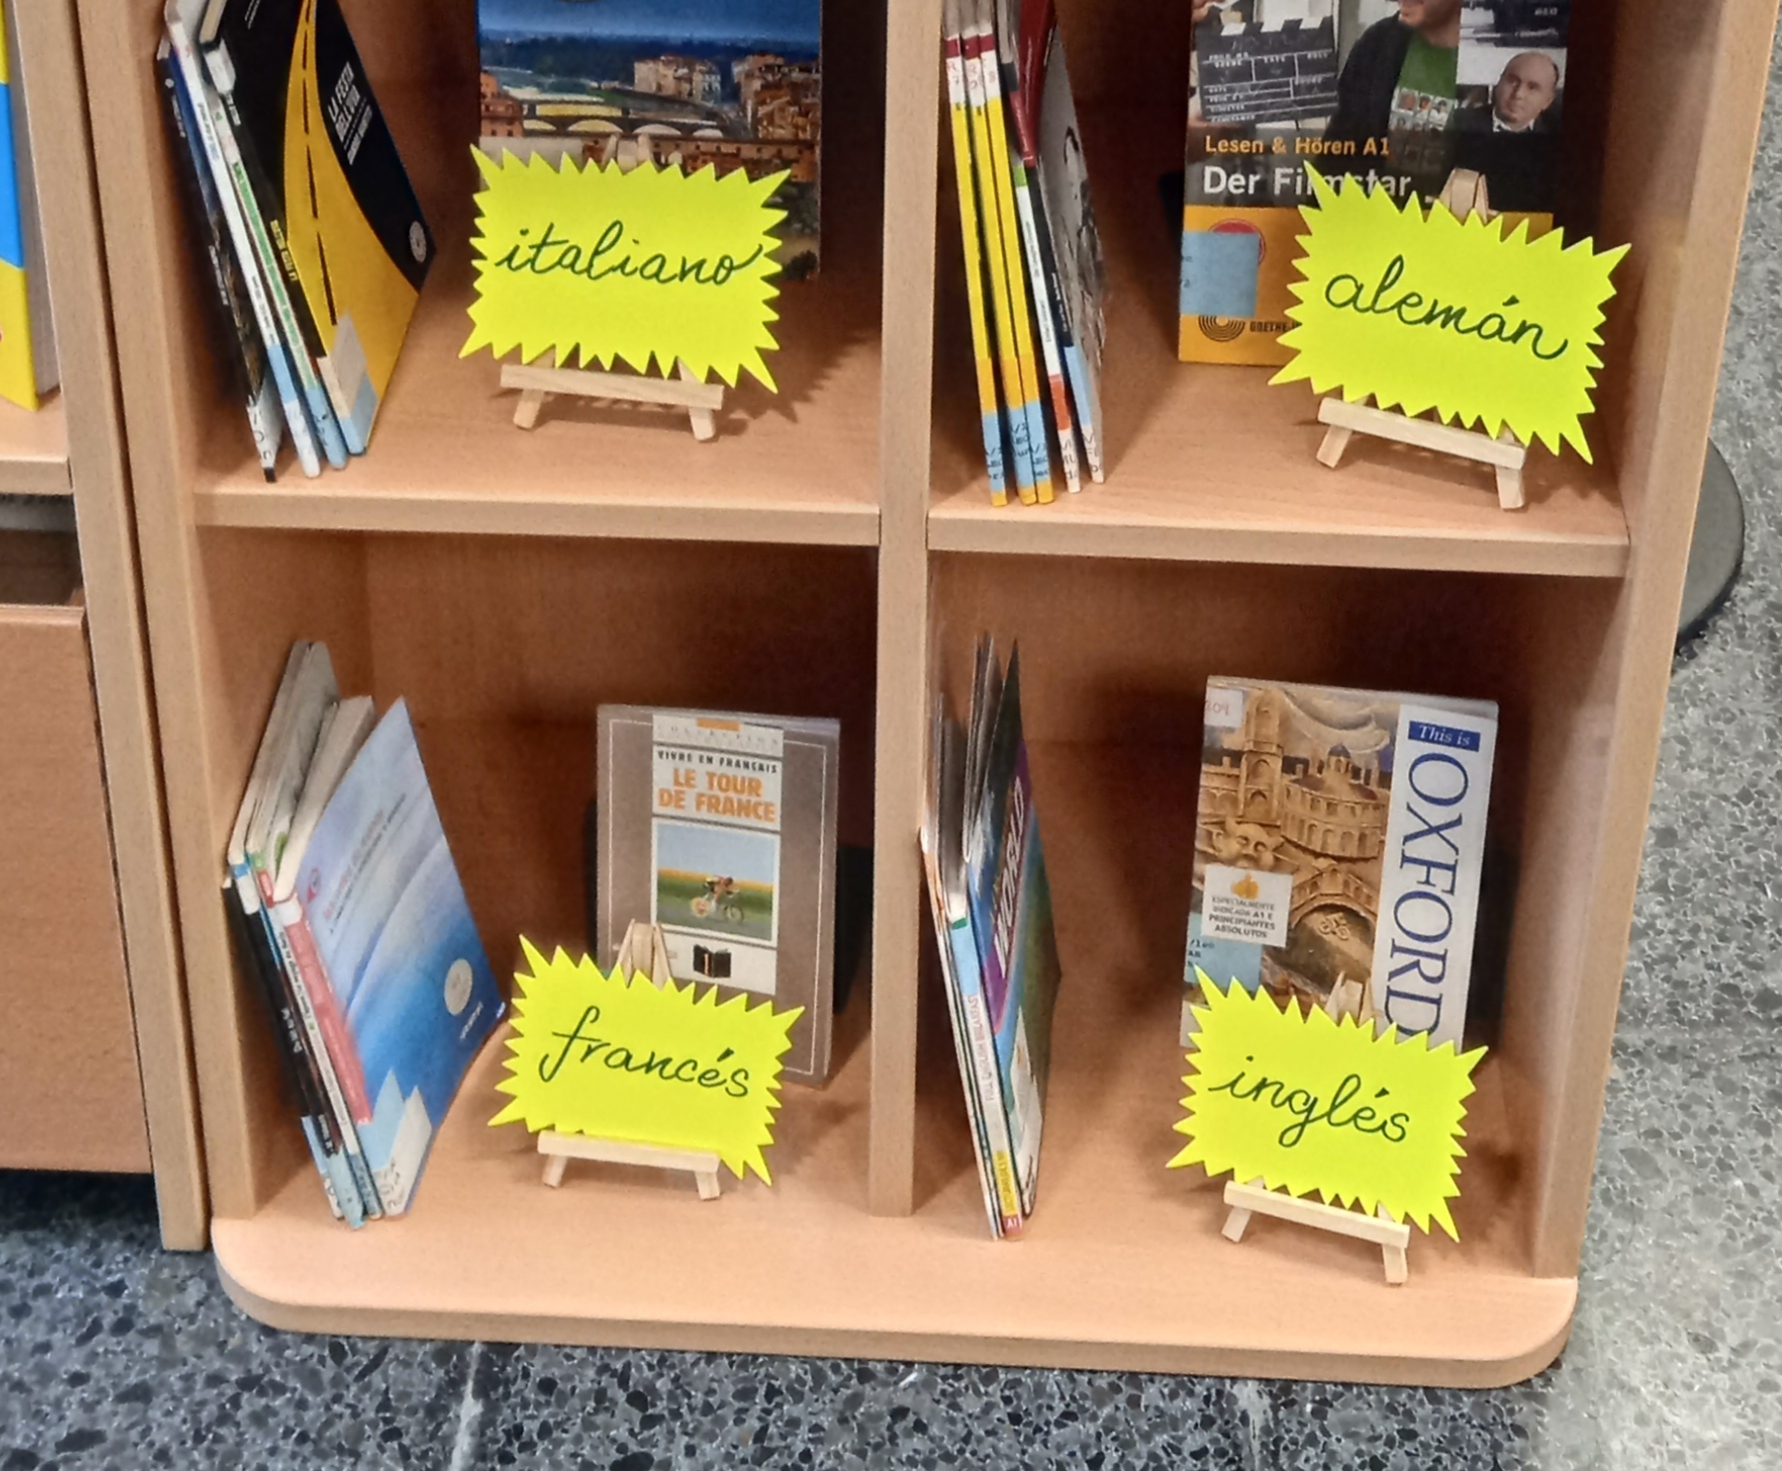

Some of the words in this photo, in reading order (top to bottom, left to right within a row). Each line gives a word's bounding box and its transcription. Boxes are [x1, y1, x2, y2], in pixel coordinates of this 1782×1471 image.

[1204, 134, 1265, 155] Lesen
[1271, 136, 1288, 154] &
[1295, 135, 1357, 157] Hören
[1362, 136, 1390, 157] A1
[1202, 164, 1260, 195] Der
[494, 219, 764, 286] italiano
[1324, 253, 1569, 361] alemán
[1417, 723, 1454, 744] This
[1455, 731, 1472, 747] is
[657, 749, 693, 763] VIVRE
[698, 754, 715, 765] EN
[672, 767, 697, 789] LE
[705, 771, 763, 798] TOUR
[658, 787, 686, 811] DE
[695, 792, 777, 824] FRANCE
[1384, 751, 1470, 1037] OXFORD
[1208, 913, 1276, 931] PRINCIPIANTES
[1252, 910, 1266, 919] A1
[1213, 923, 1268, 939] ABSOLUTOS
[538, 1004, 751, 1099] francés
[1207, 1054, 1410, 1149] inglés
